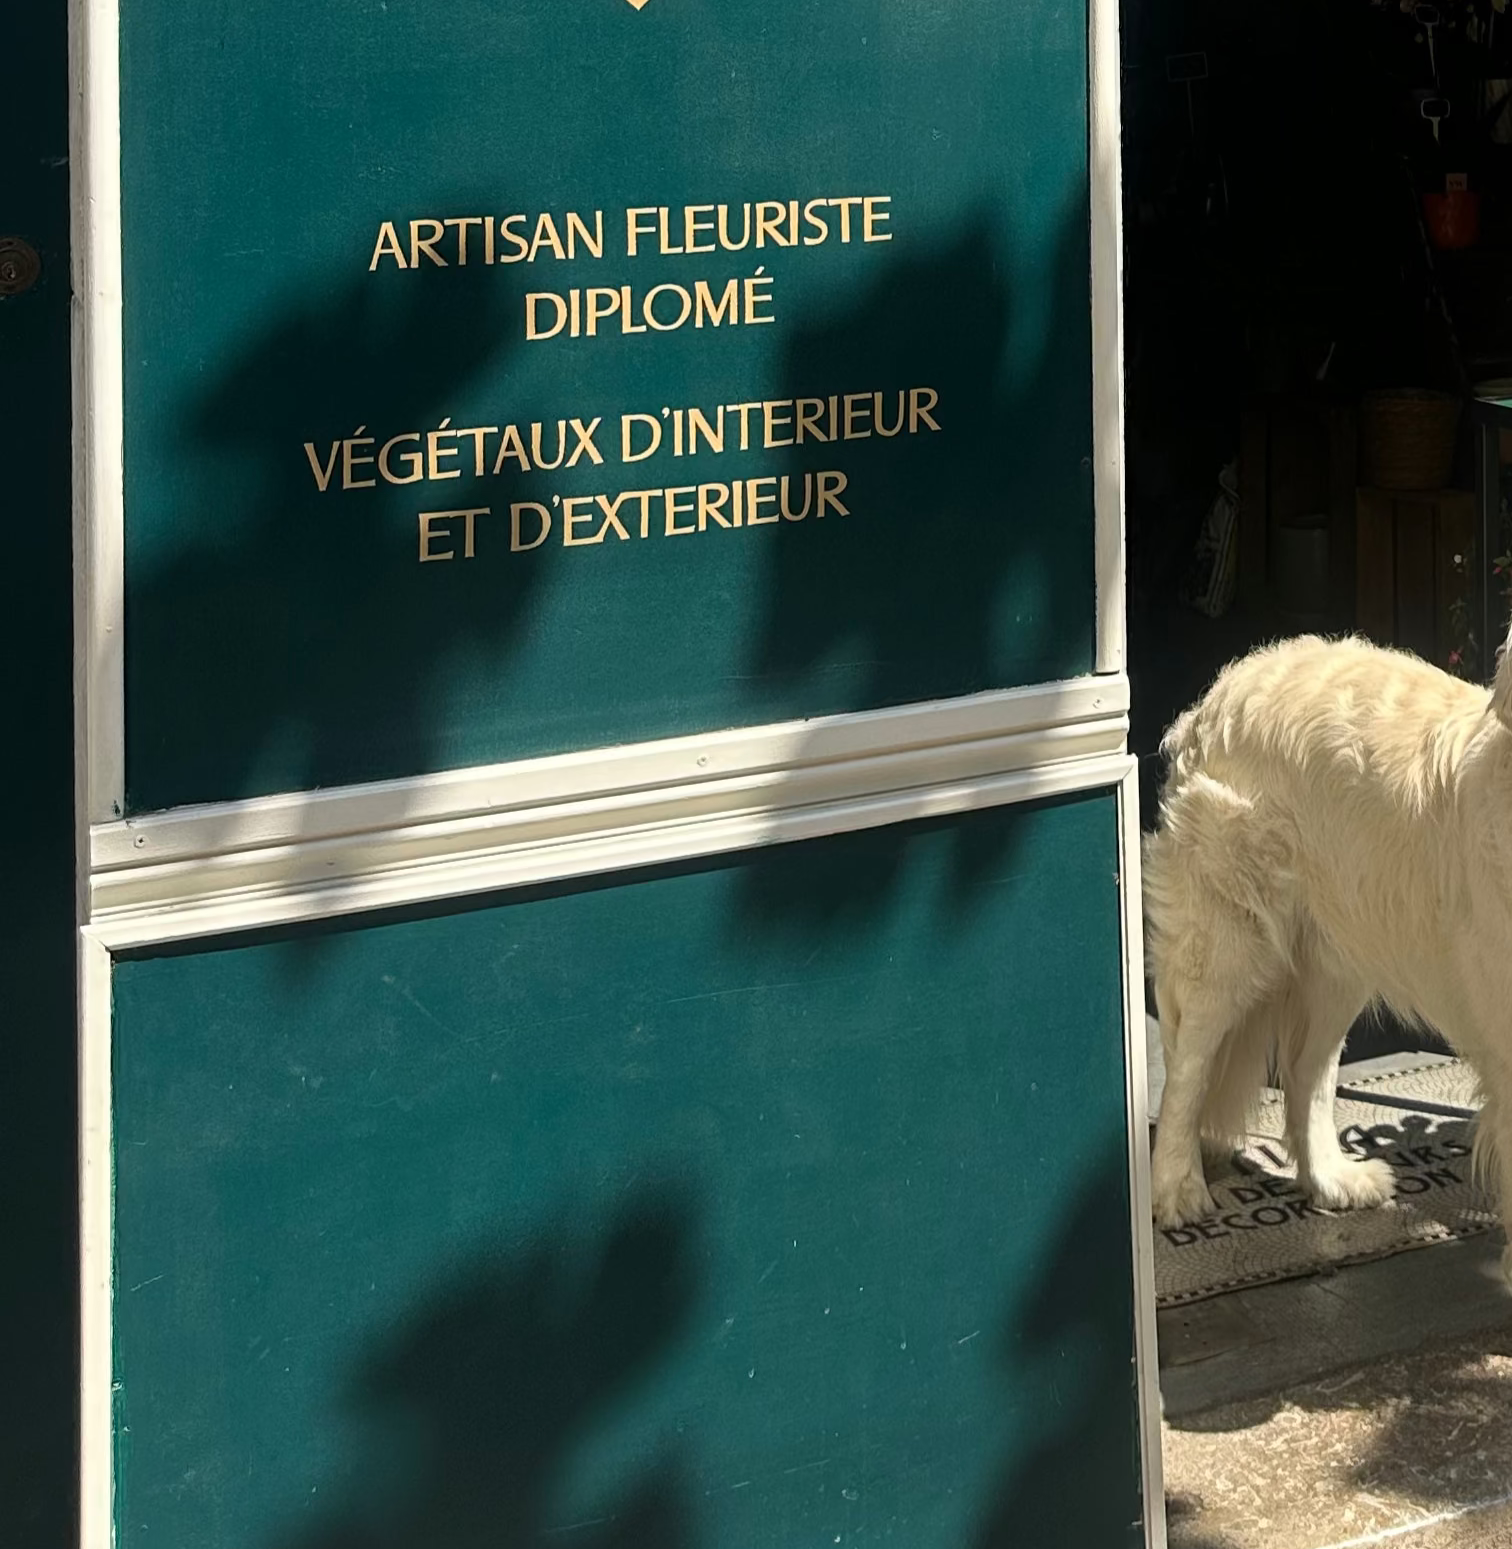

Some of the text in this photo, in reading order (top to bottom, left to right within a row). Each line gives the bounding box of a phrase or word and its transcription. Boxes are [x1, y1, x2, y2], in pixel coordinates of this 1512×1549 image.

[370, 196, 892, 271] ARTISAN FLEURISTE
[526, 267, 774, 340] DIPLOMÉ
[304, 388, 941, 491] VÉGÉTAUX D'INTERIEUR
[419, 471, 849, 561] ET D'EXTERIEUR
[1228, 1178, 1297, 1205] DE
